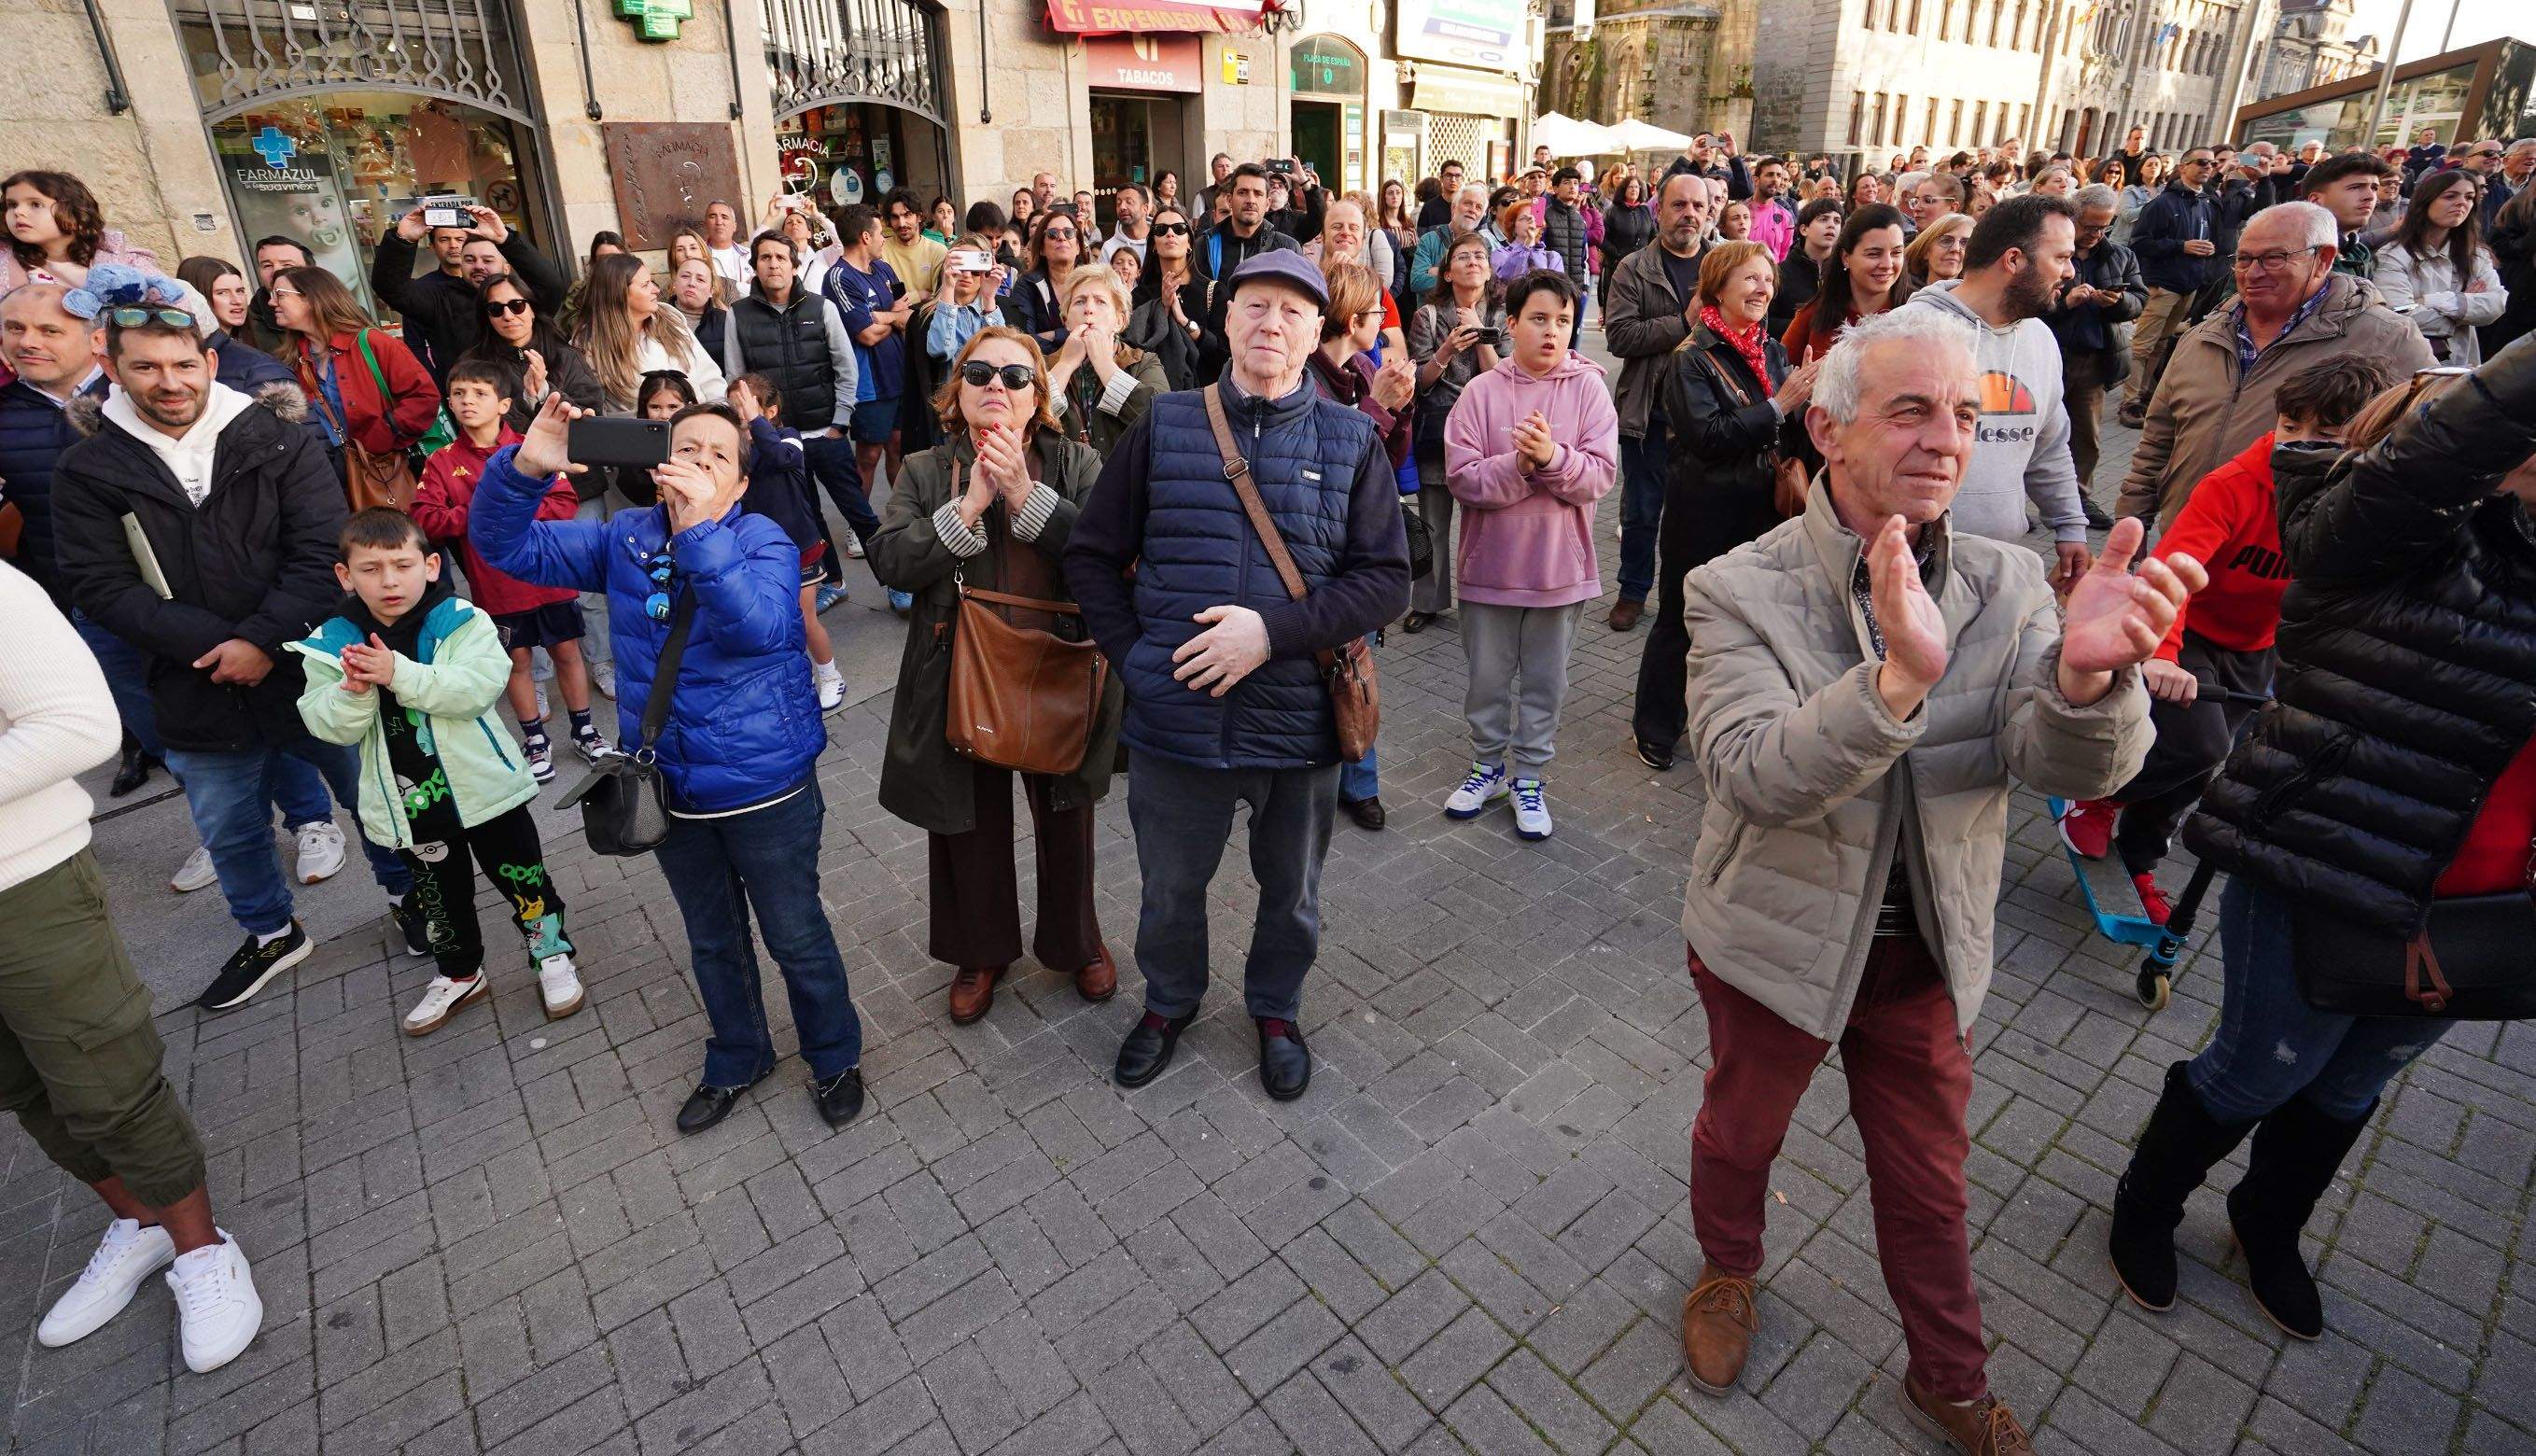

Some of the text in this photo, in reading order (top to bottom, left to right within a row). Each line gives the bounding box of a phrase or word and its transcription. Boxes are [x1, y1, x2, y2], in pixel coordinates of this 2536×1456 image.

[1303, 53, 1322, 63] PLAZA
[1323, 56, 1330, 64] DE
[1117, 69, 1173, 86] TABACOS
[777, 136, 829, 158] ARMACIA
[236, 169, 322, 181] FARMAZUL
[430, 200, 460, 208] ENTRADA
[1973, 421, 2034, 442] lesse
[2227, 545, 2293, 581] PUM
